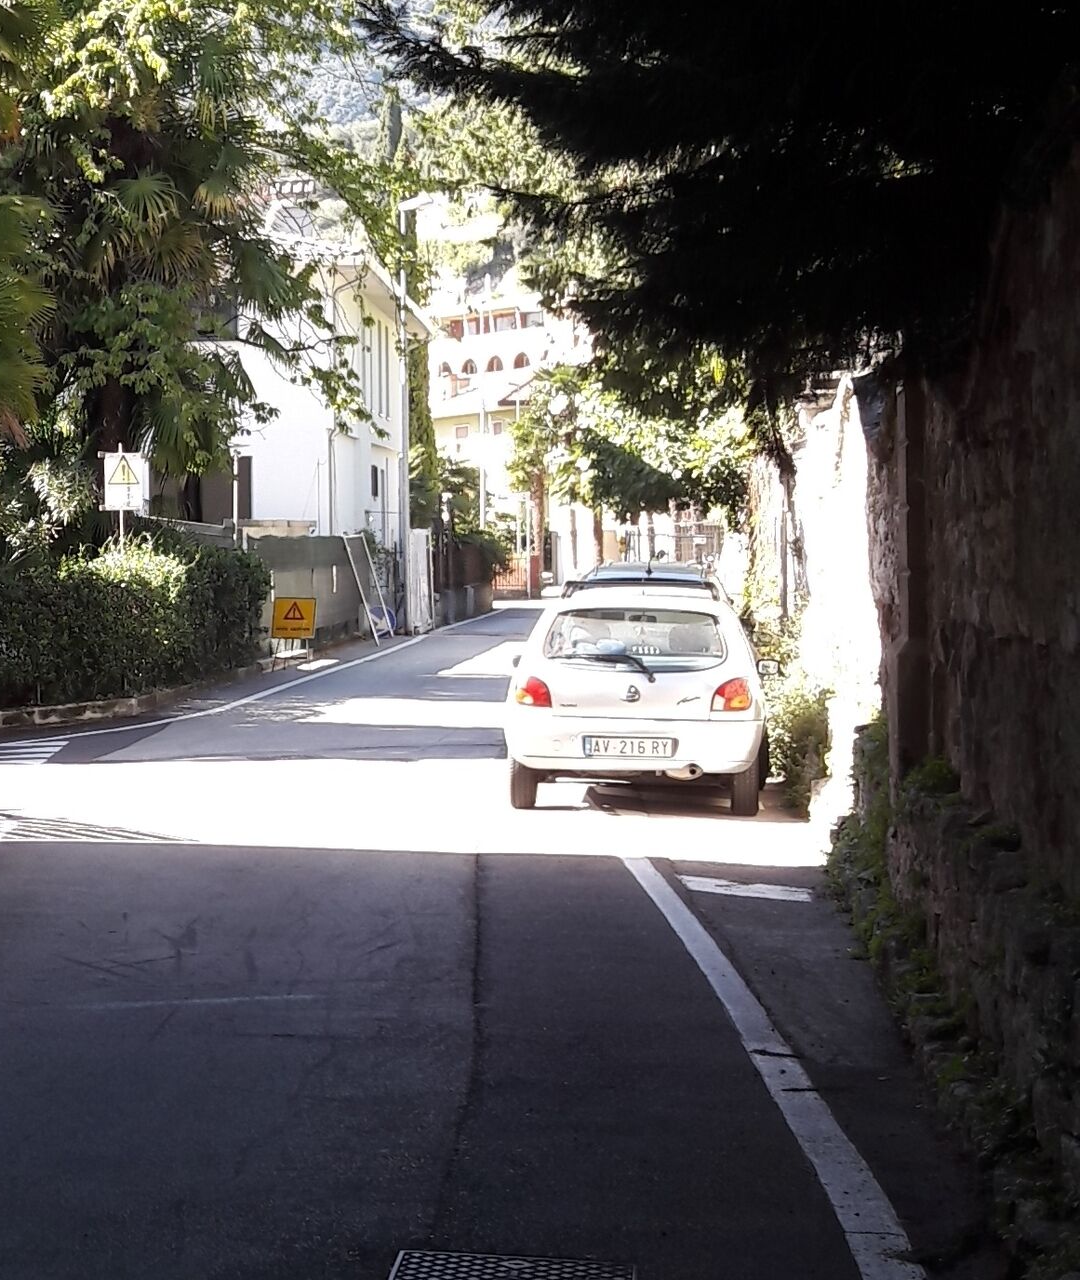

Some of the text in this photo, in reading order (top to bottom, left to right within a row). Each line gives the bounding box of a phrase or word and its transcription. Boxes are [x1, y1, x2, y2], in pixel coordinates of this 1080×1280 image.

[593, 739, 669, 755] AV 216 RY
